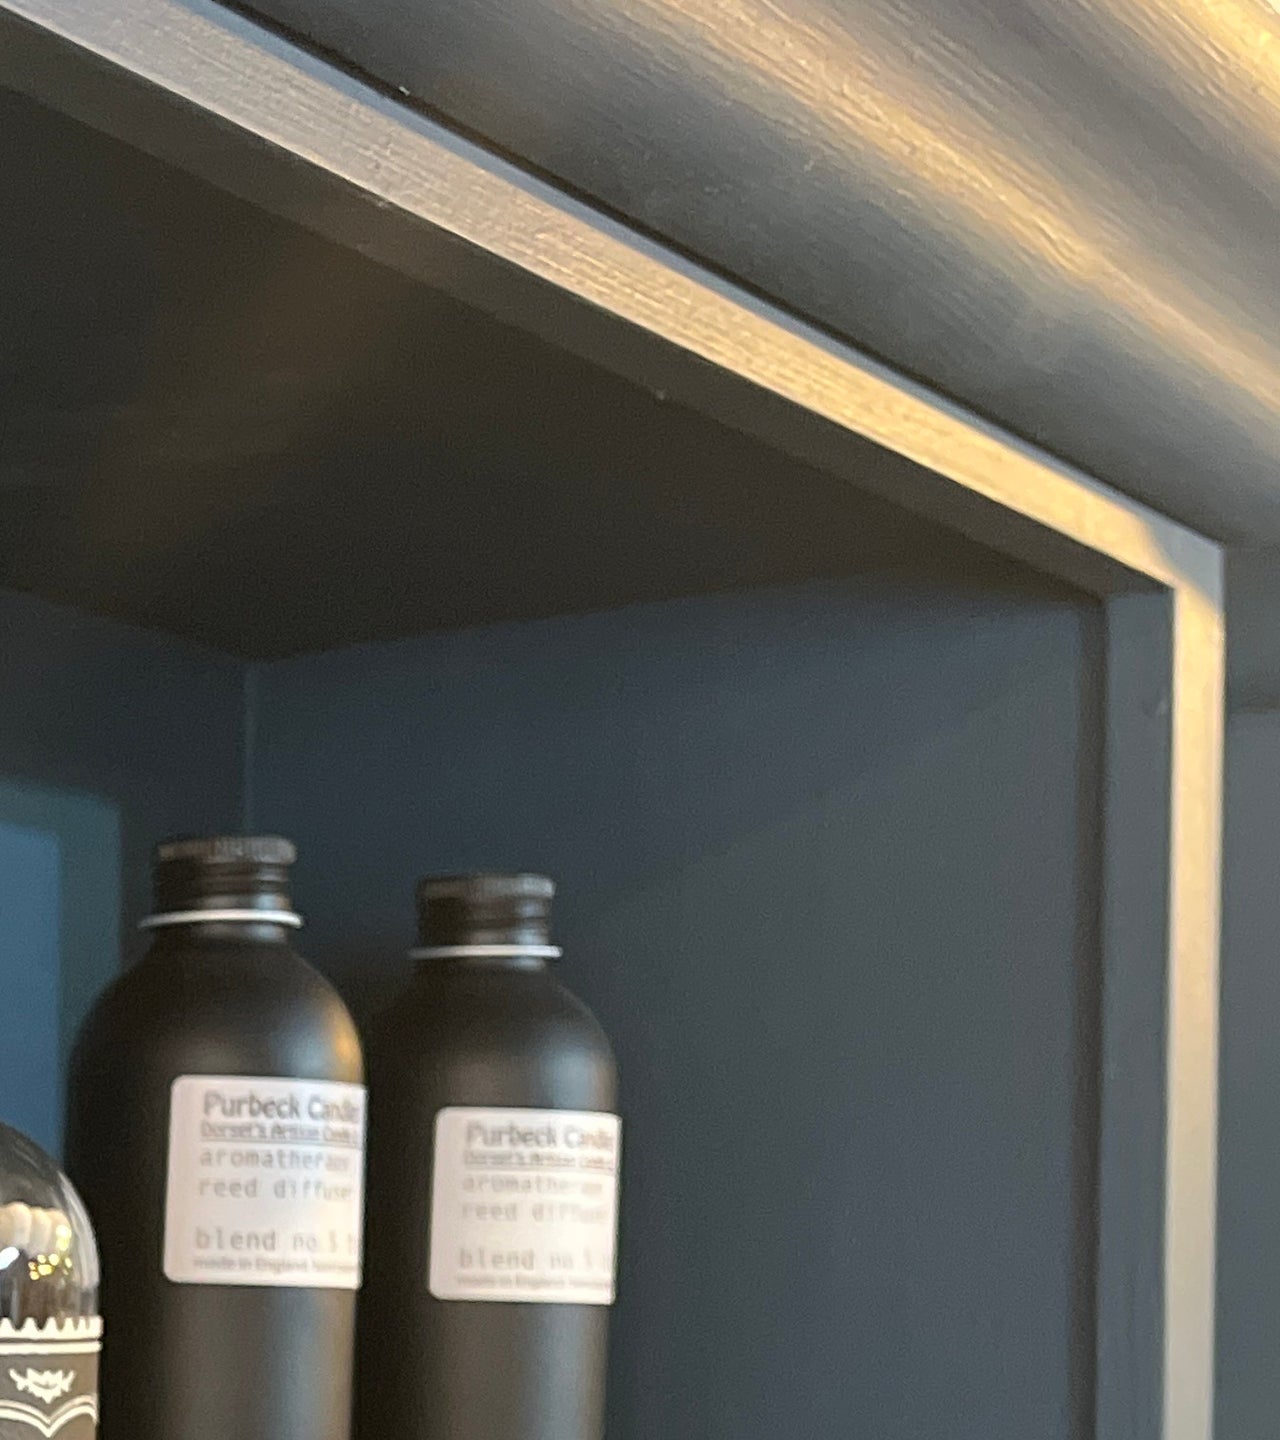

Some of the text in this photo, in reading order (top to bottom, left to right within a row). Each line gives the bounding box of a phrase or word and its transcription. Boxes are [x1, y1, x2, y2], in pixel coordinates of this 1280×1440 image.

[203, 1089, 301, 1119] Purbeck
[198, 1179, 259, 1199] reed
[195, 1227, 277, 1251] blend
